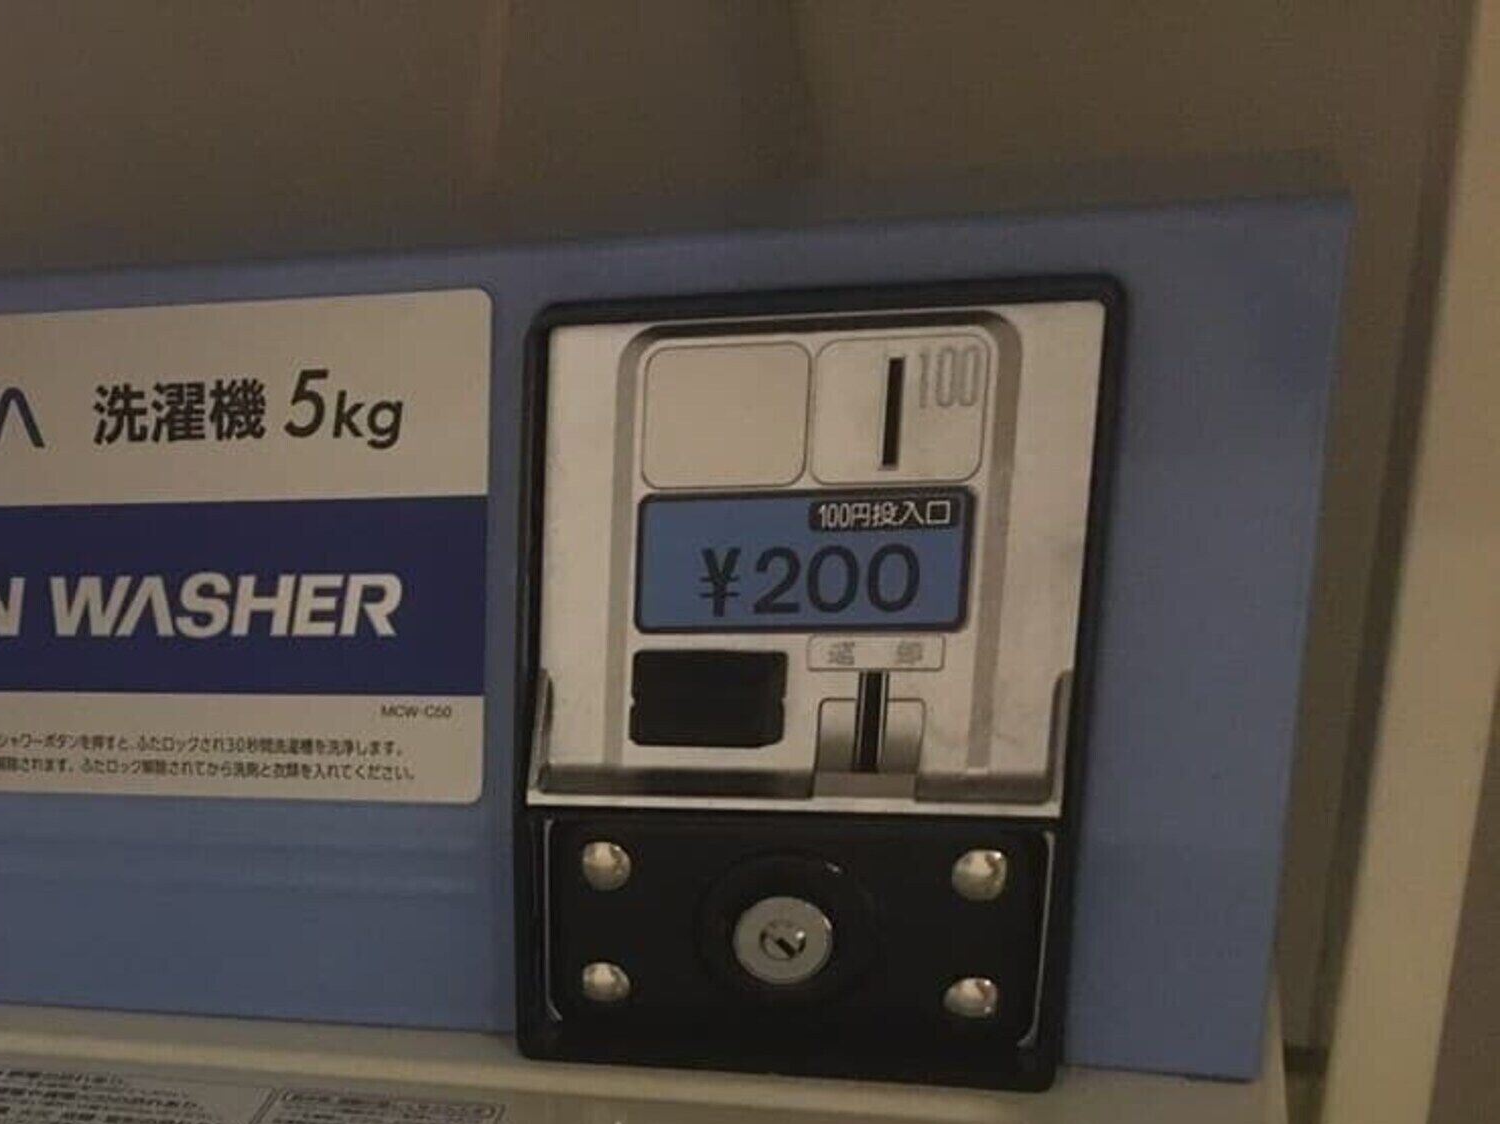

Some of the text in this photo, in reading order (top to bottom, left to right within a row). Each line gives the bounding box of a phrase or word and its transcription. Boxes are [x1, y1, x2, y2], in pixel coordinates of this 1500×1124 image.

[92, 368, 403, 450] 洗濯機 5kg
[919, 346, 981, 408] 100
[816, 501, 951, 528] 100円投入口
[50, 573, 403, 639] WASHER
[700, 544, 921, 617] ¥200
